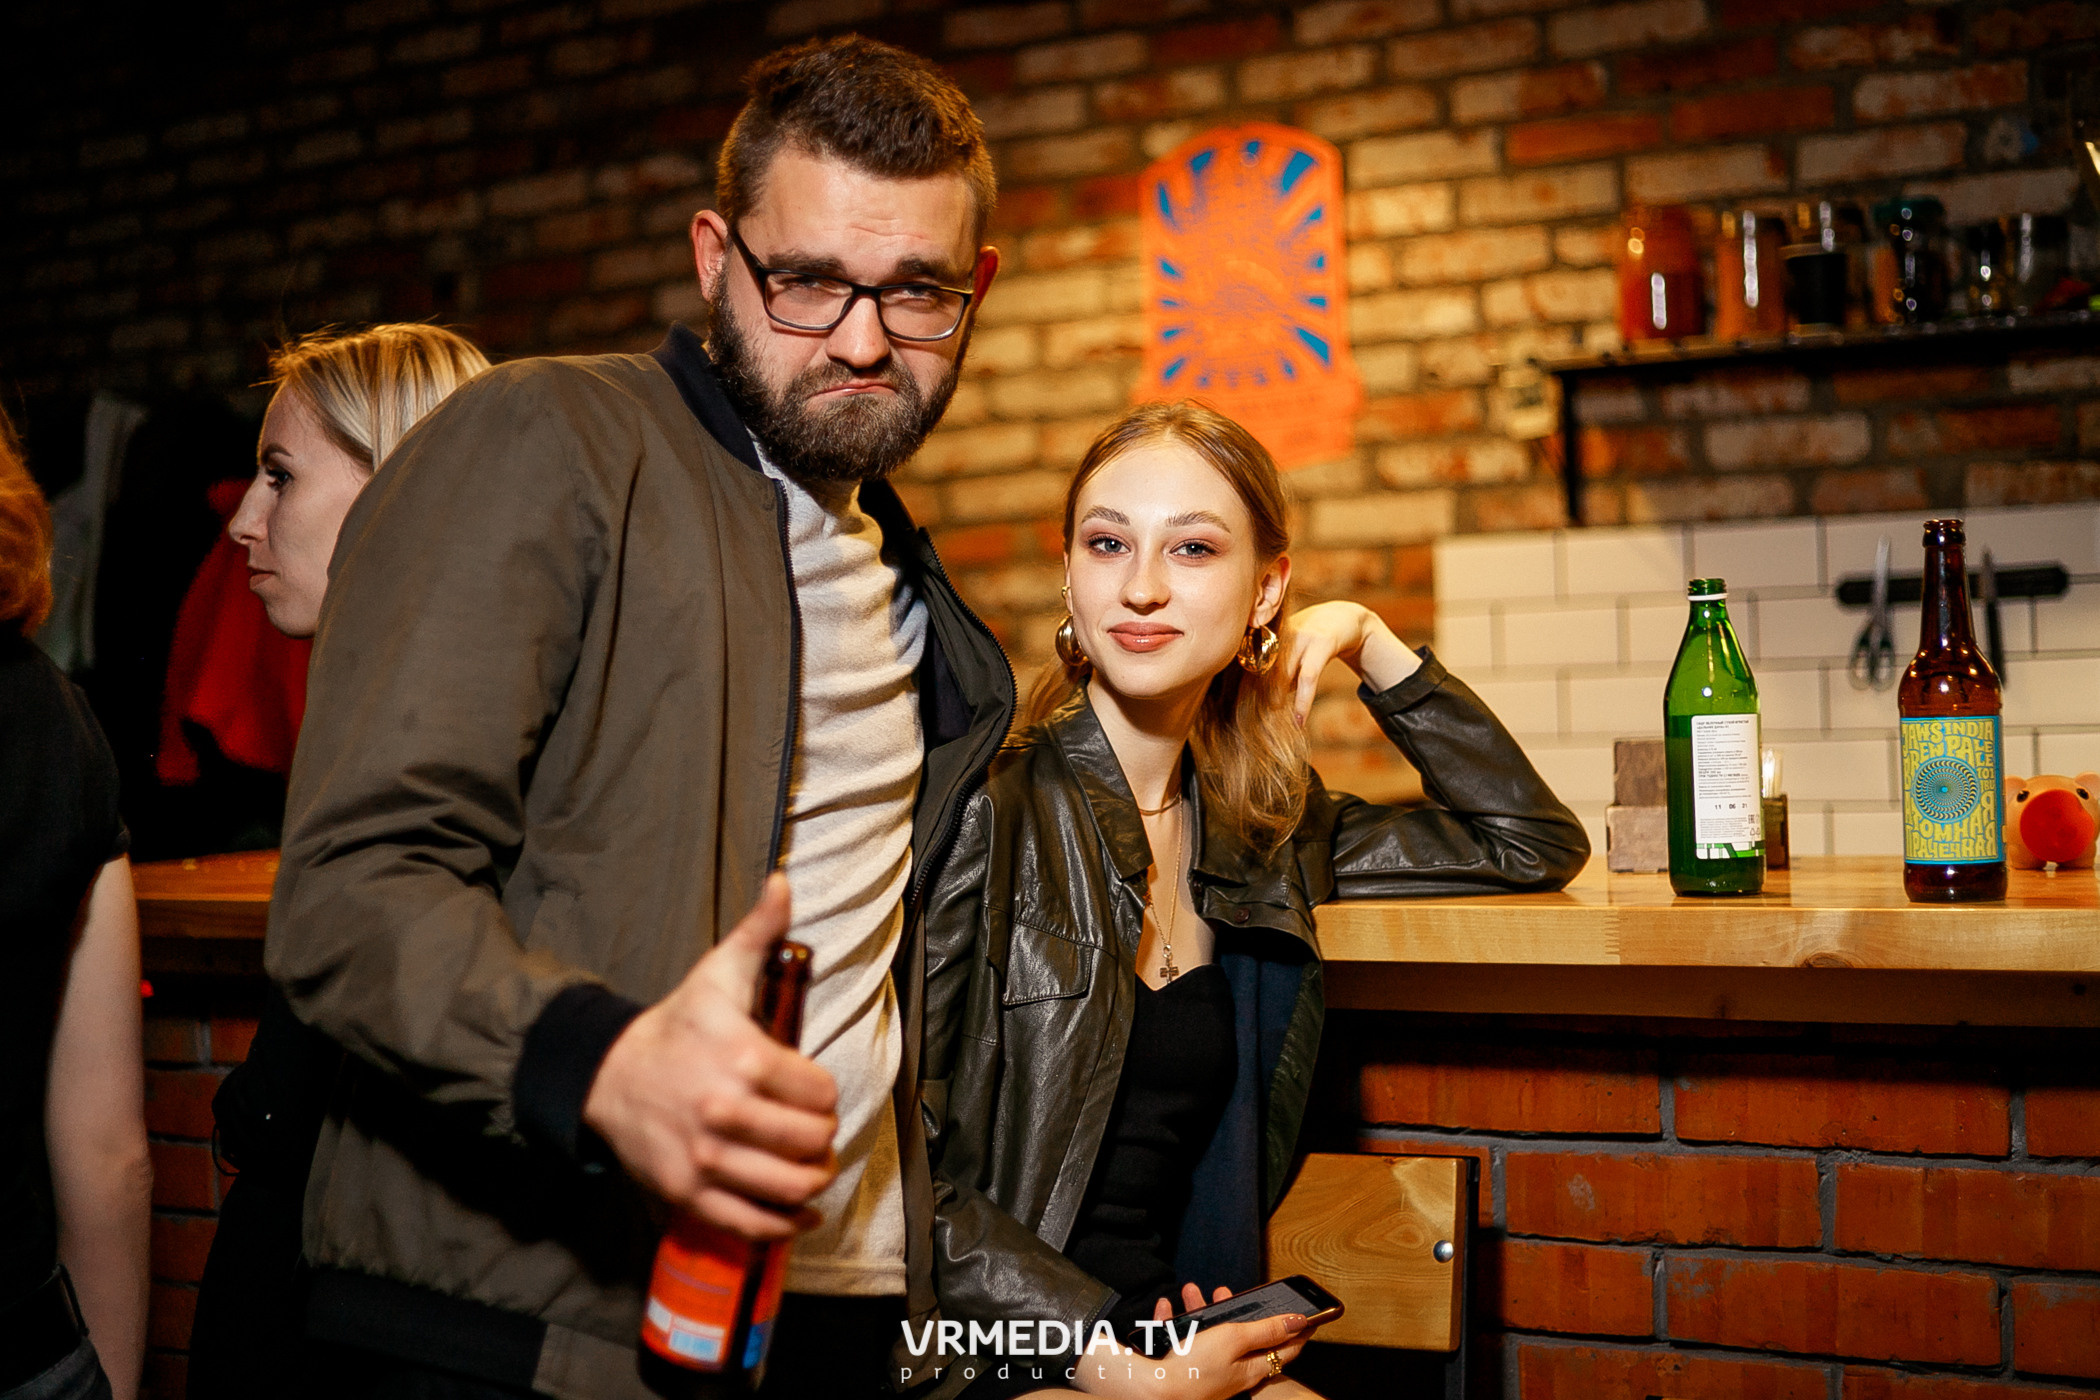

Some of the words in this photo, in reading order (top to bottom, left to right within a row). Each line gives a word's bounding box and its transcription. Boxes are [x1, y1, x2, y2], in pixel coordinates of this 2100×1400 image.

[1902, 722, 1944, 758] JAWS
[1944, 721, 1994, 740] INDIA
[1902, 741, 1945, 790] BREW
[1977, 767, 1995, 779] 101
[1904, 790, 1995, 842] АТОМНАЯ
[1905, 821, 1996, 857] ПРАЧЕЧНАЯ
